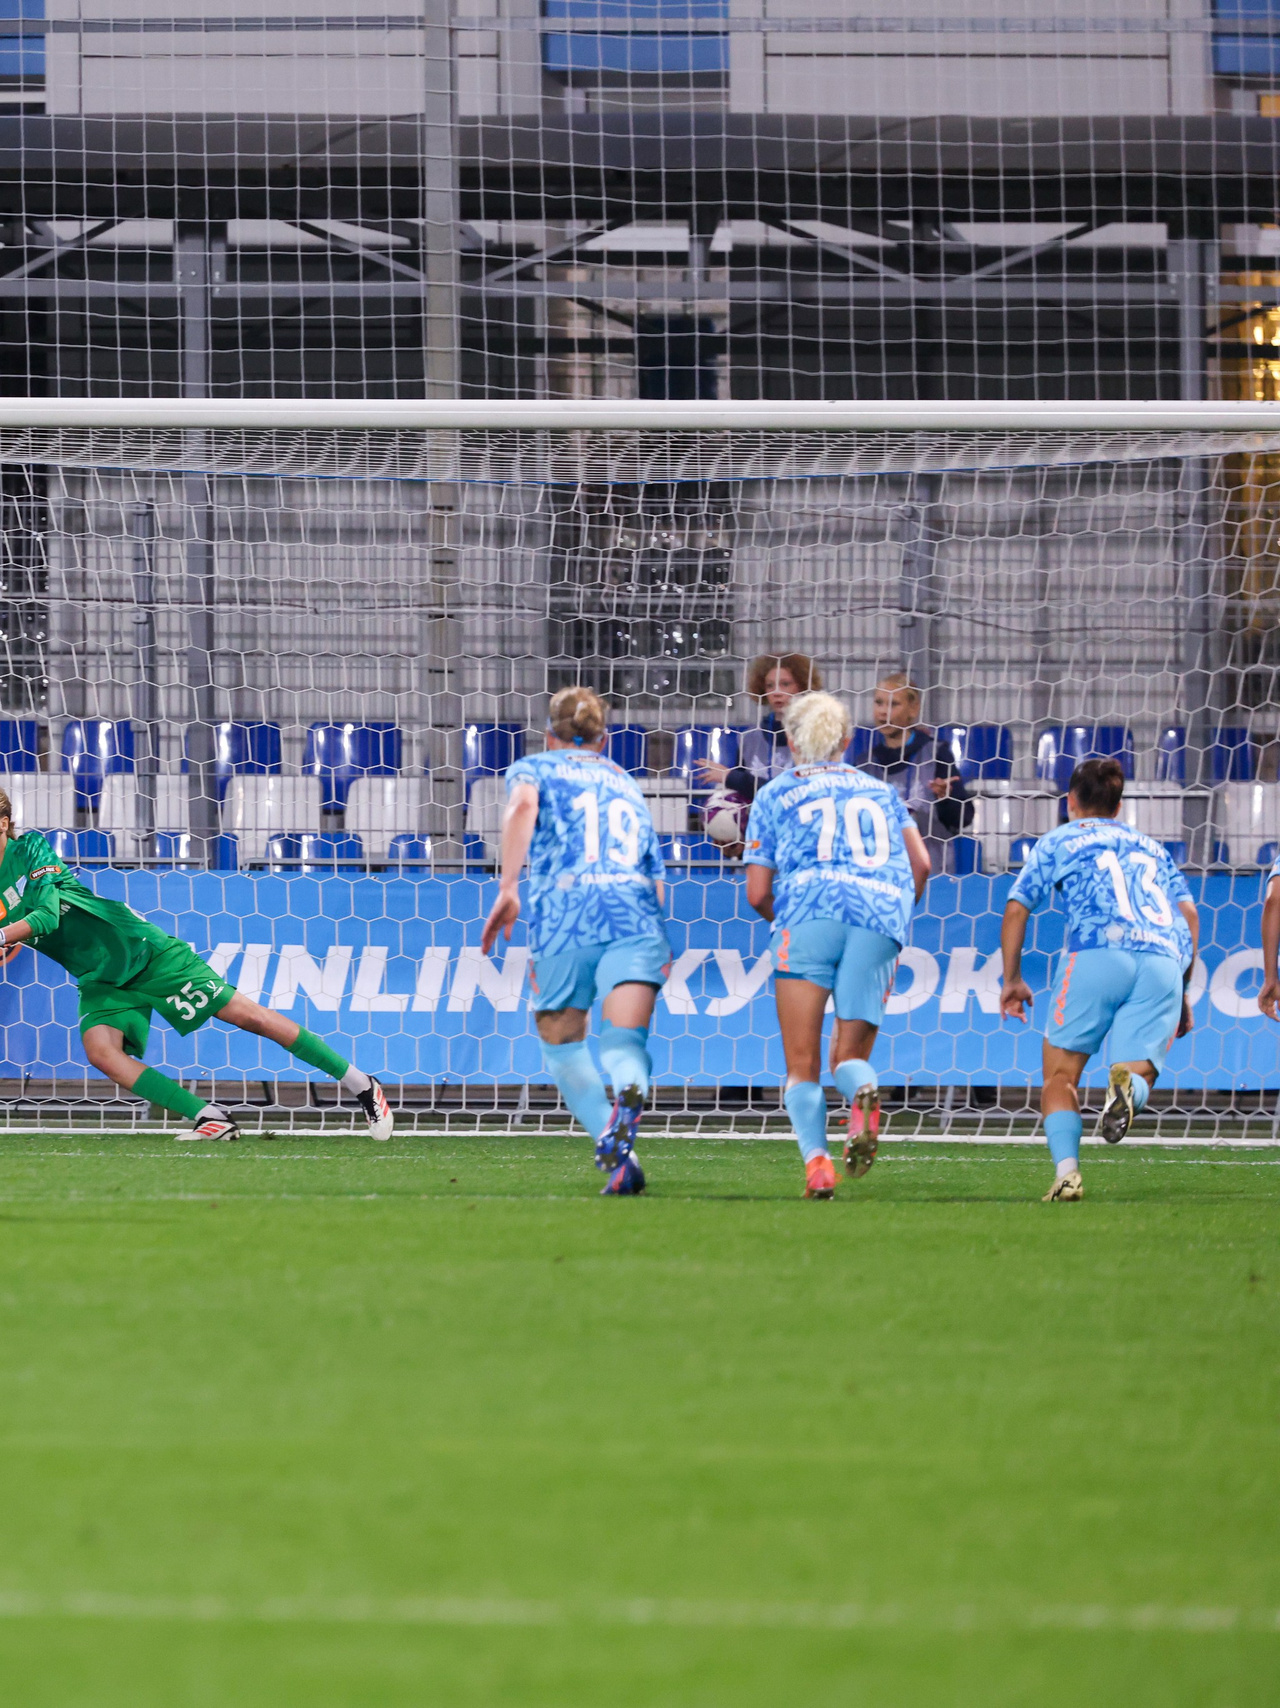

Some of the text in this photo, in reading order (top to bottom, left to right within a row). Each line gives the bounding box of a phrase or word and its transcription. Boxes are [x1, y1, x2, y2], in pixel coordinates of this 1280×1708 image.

[572, 791, 640, 867] 19
[798, 796, 891, 868] 70
[1096, 850, 1173, 926] 13
[166, 981, 208, 1020] 35
[661, 946, 1004, 1016] КУОК
